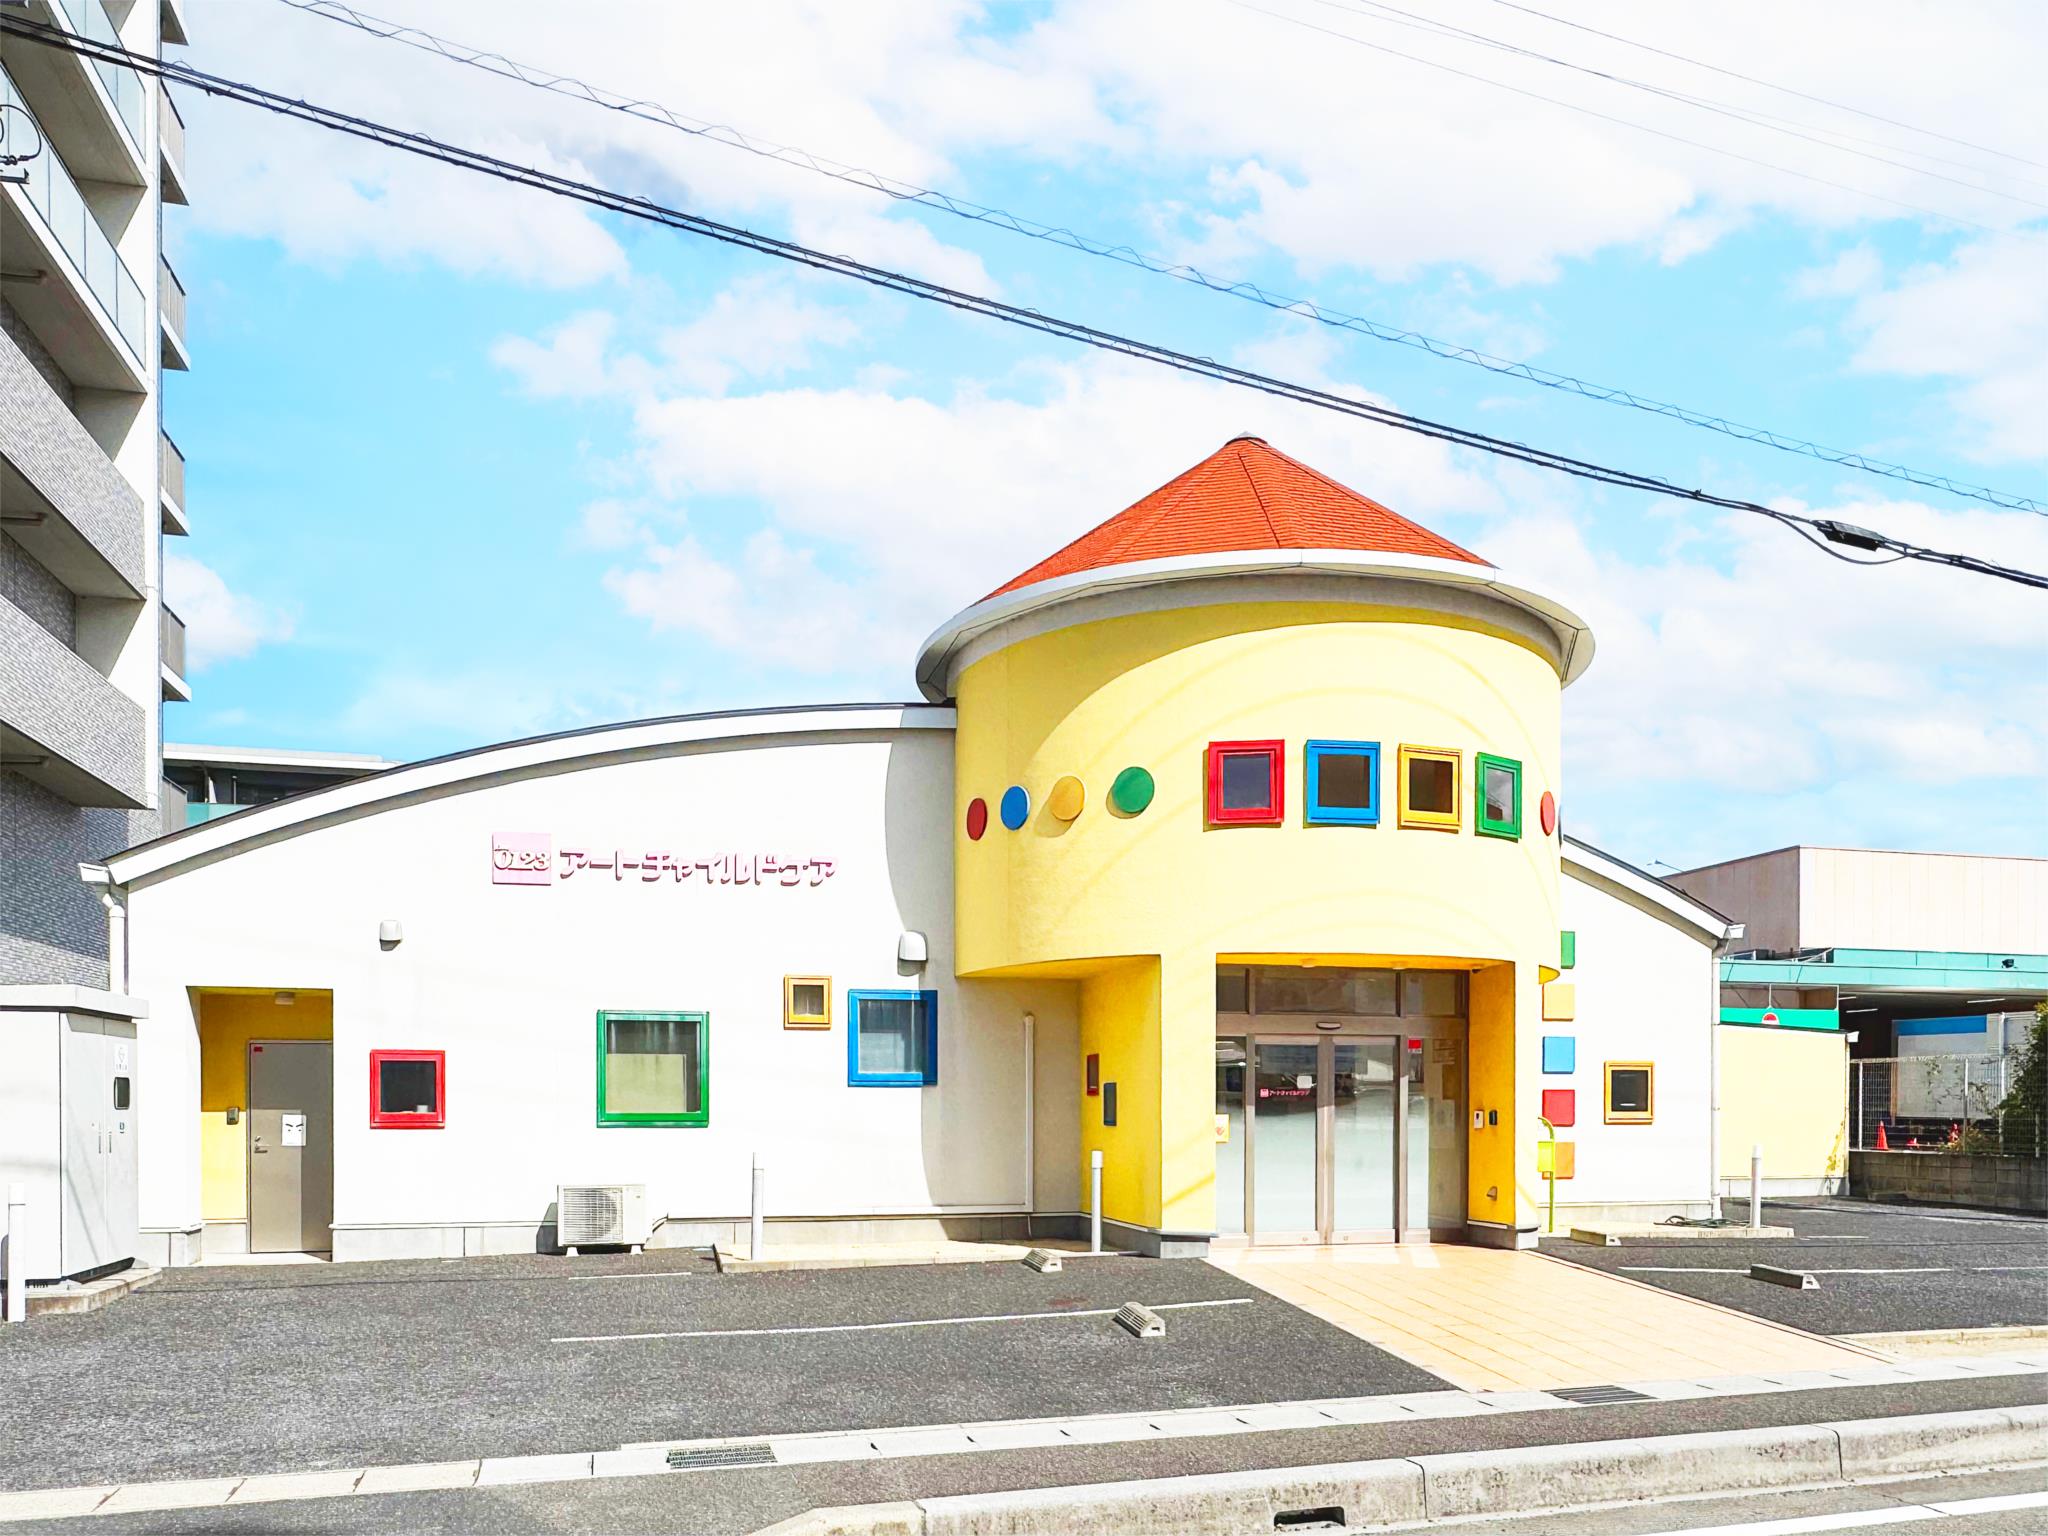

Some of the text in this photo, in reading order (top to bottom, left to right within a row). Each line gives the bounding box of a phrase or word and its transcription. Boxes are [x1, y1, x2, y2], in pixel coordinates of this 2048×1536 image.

[559, 849, 837, 887] アートチャイルドケア
